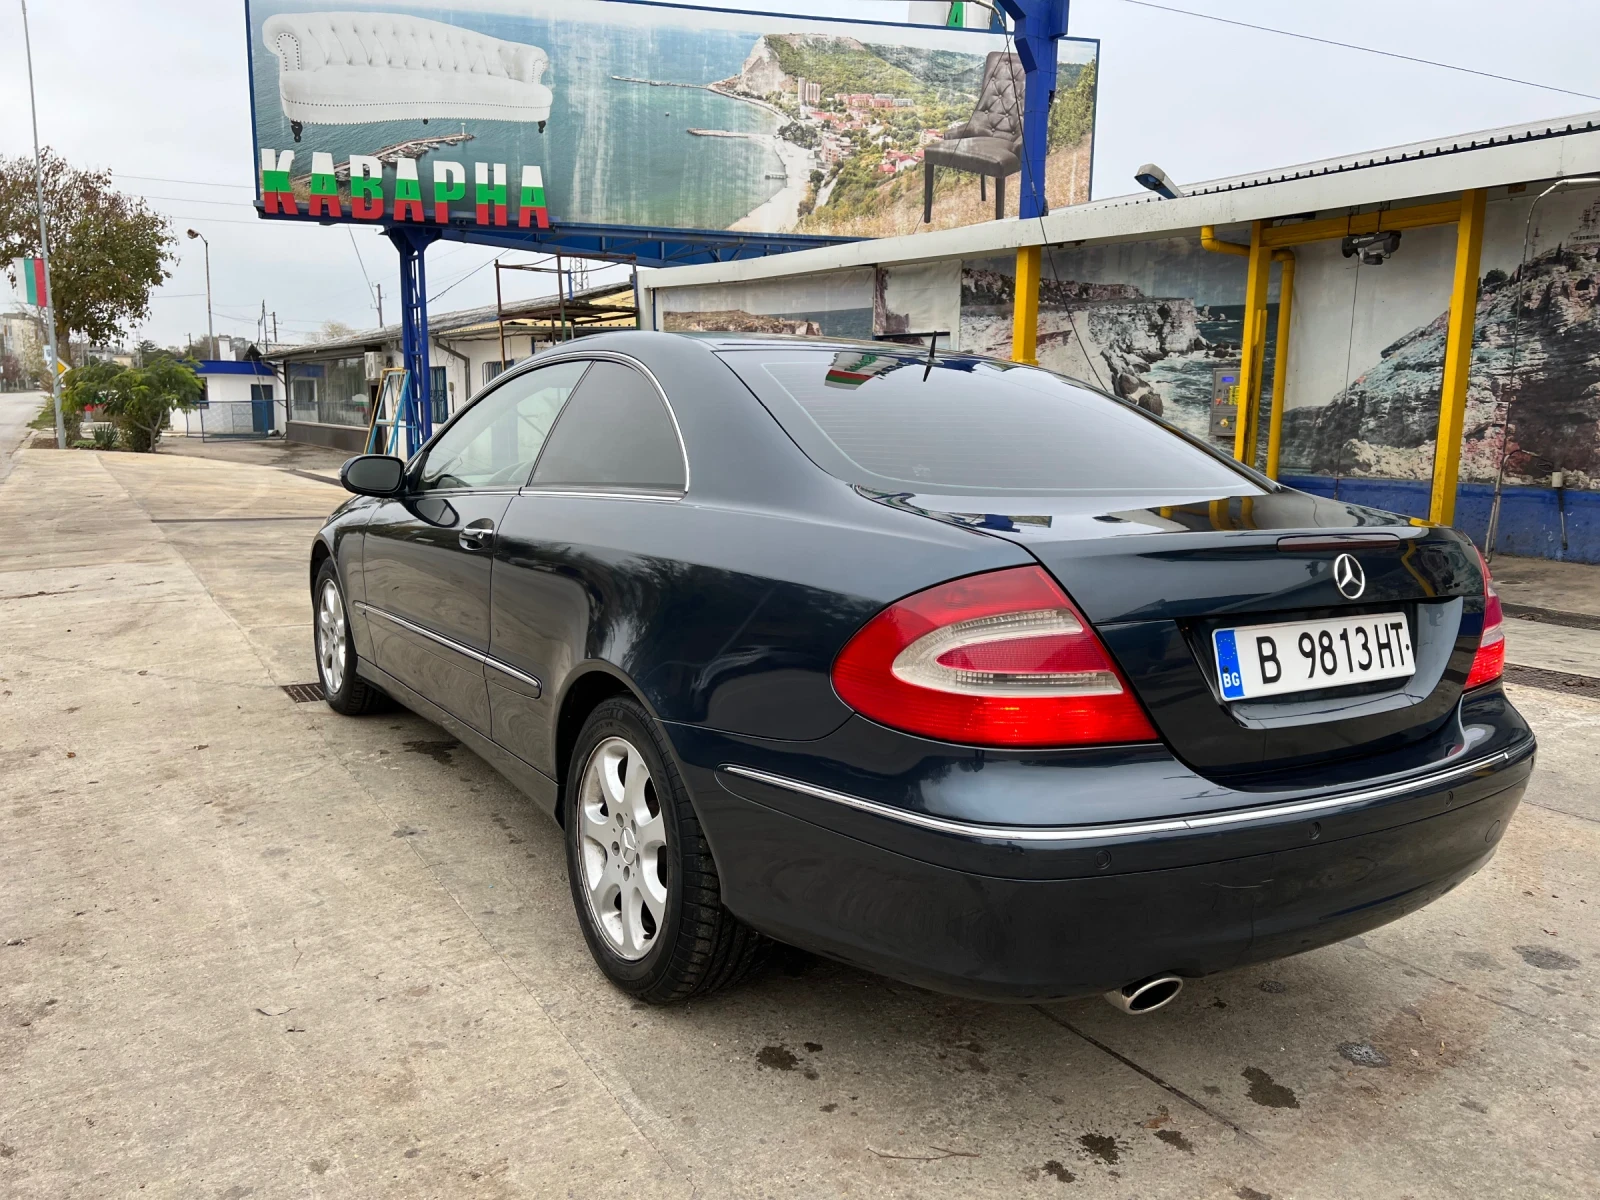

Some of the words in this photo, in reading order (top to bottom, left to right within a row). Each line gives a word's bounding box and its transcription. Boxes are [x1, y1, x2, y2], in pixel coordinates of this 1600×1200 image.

[261, 148, 549, 228] КАВАРНА
[1222, 672, 1241, 688] BG
[1255, 635, 1282, 684] B
